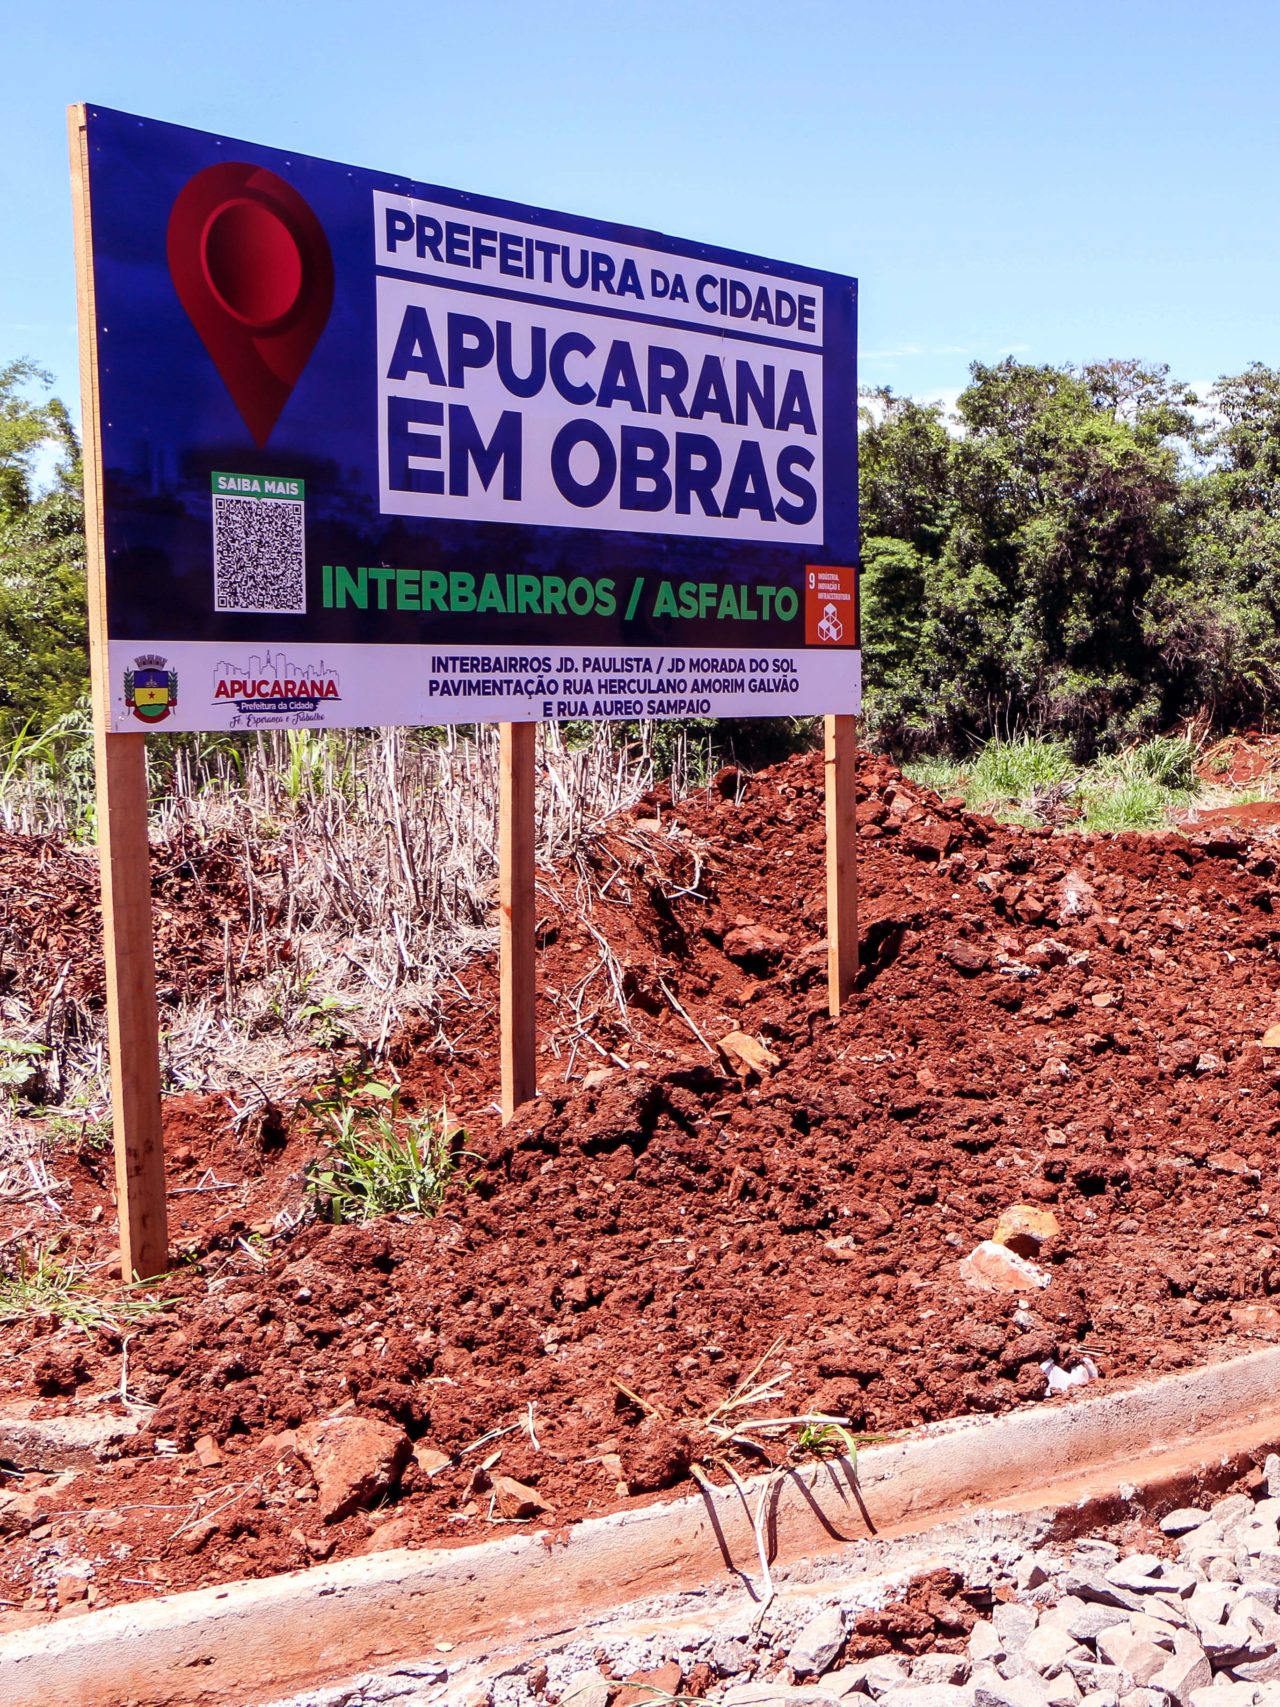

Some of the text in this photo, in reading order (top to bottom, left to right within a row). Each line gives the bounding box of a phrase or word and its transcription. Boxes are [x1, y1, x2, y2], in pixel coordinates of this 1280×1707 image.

[386, 207, 816, 333] PREFEITURA DA CIDADE
[386, 304, 818, 436] APUCARANA
[387, 395, 818, 526] EM OBRAS
[218, 476, 299, 495] SAIBA MAIS
[809, 572, 816, 590] 9
[322, 565, 799, 622] INTERBAIRROS / ASFALTO
[431, 656, 797, 674] INTERBAIRROS JD. PAULISTA / JD MORADA DO SOL
[214, 679, 339, 699] APUCARANA
[429, 675, 799, 700] PAVIMENTAÇÃO RUA HERCULANO AMORIM GALVÃO
[241, 700, 314, 710] Prefeitura da Cidade
[543, 699, 711, 717] E RUA AUREO SAMPAIO
